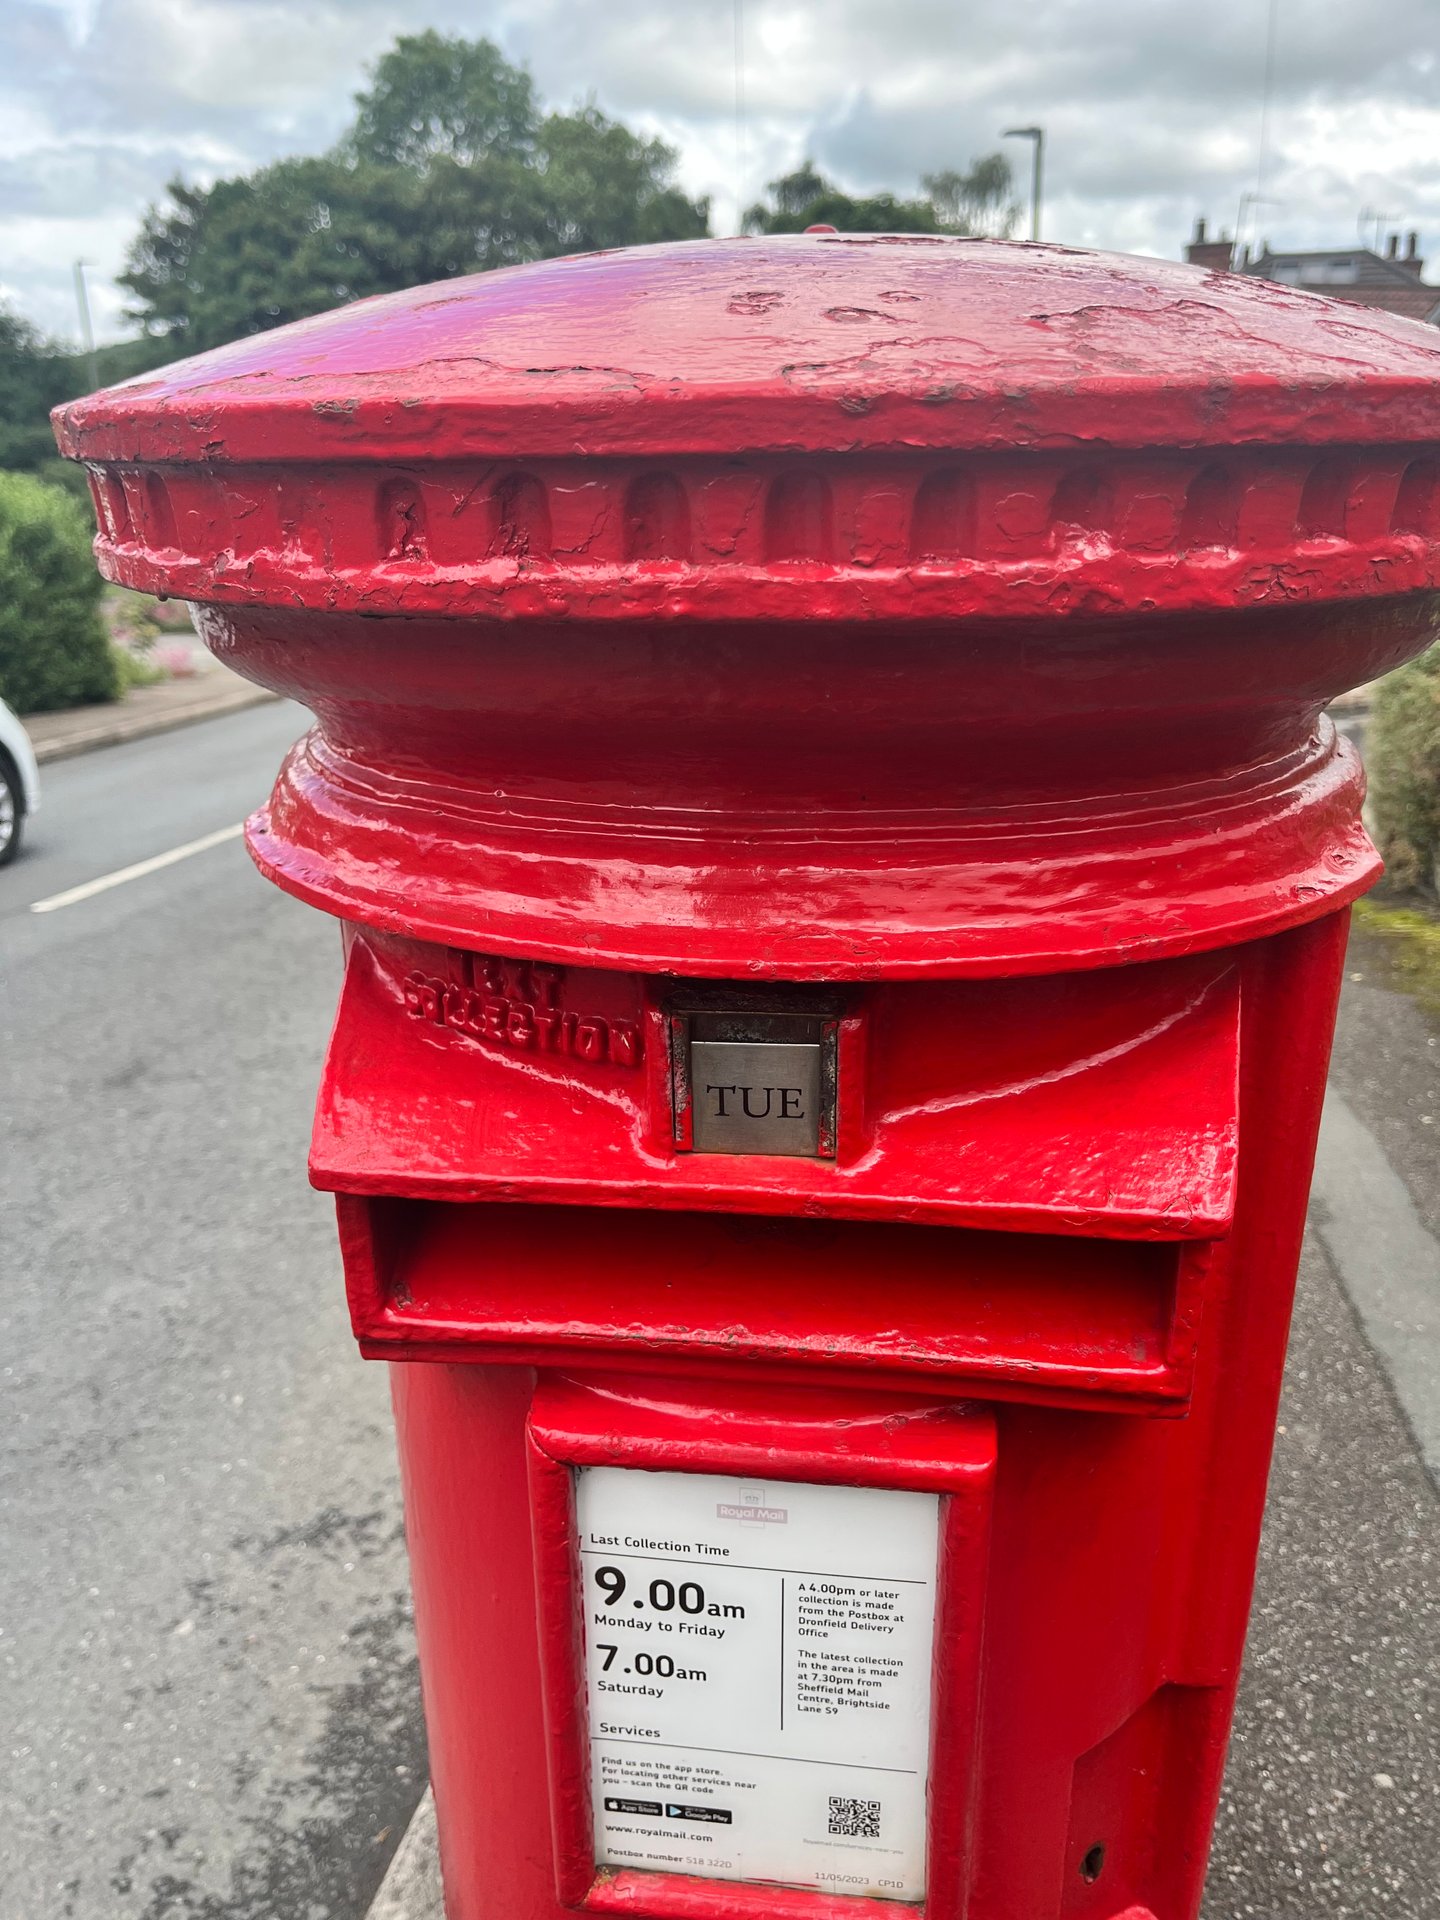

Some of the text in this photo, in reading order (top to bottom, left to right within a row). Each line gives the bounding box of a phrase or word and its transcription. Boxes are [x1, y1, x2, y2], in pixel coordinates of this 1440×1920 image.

[706, 1084, 806, 1119] TUE
[719, 1505, 786, 1521] Royal Mail
[590, 1533, 730, 1557] Last Collection Time
[594, 1565, 745, 1620] 9.00am
[798, 1583, 806, 1591] A
[809, 1583, 856, 1596] 4.00pm
[874, 1590, 900, 1599] later
[798, 1595, 894, 1610] collection is made
[798, 1605, 904, 1623] from the Postbox at
[594, 1613, 725, 1640] Monday to Friday
[798, 1616, 894, 1634] Dronfield Delivery
[798, 1627, 829, 1638] Office
[595, 1643, 707, 1682] 7.00am
[797, 1649, 904, 1667] The latest collection
[797, 1660, 899, 1677] in the area is made
[797, 1672, 882, 1688] at 7.30pm from
[597, 1680, 664, 1699] Saturday
[797, 1682, 869, 1697] Sheffield Mail
[797, 1693, 890, 1710] Centre, Brightside
[797, 1703, 838, 1715] Lane S9
[599, 1722, 661, 1738] Services
[601, 1756, 622, 1765] Find
[655, 1762, 671, 1770] the
[674, 1765, 692, 1774] app
[695, 1767, 723, 1776] store.
[602, 1766, 618, 1774] For
[620, 1768, 659, 1780] locating
[662, 1773, 688, 1782] other
[691, 1777, 731, 1787] services
[602, 1777, 620, 1785] you
[655, 1781, 671, 1789] the
[674, 1783, 688, 1791] QR
[691, 1786, 714, 1794] code
[605, 1825, 713, 1842] www.royalmail.com
[606, 1847, 643, 1858] Postbox
[646, 1853, 683, 1863] number
[815, 1872, 904, 1889] 11/05/2023 CP1D
